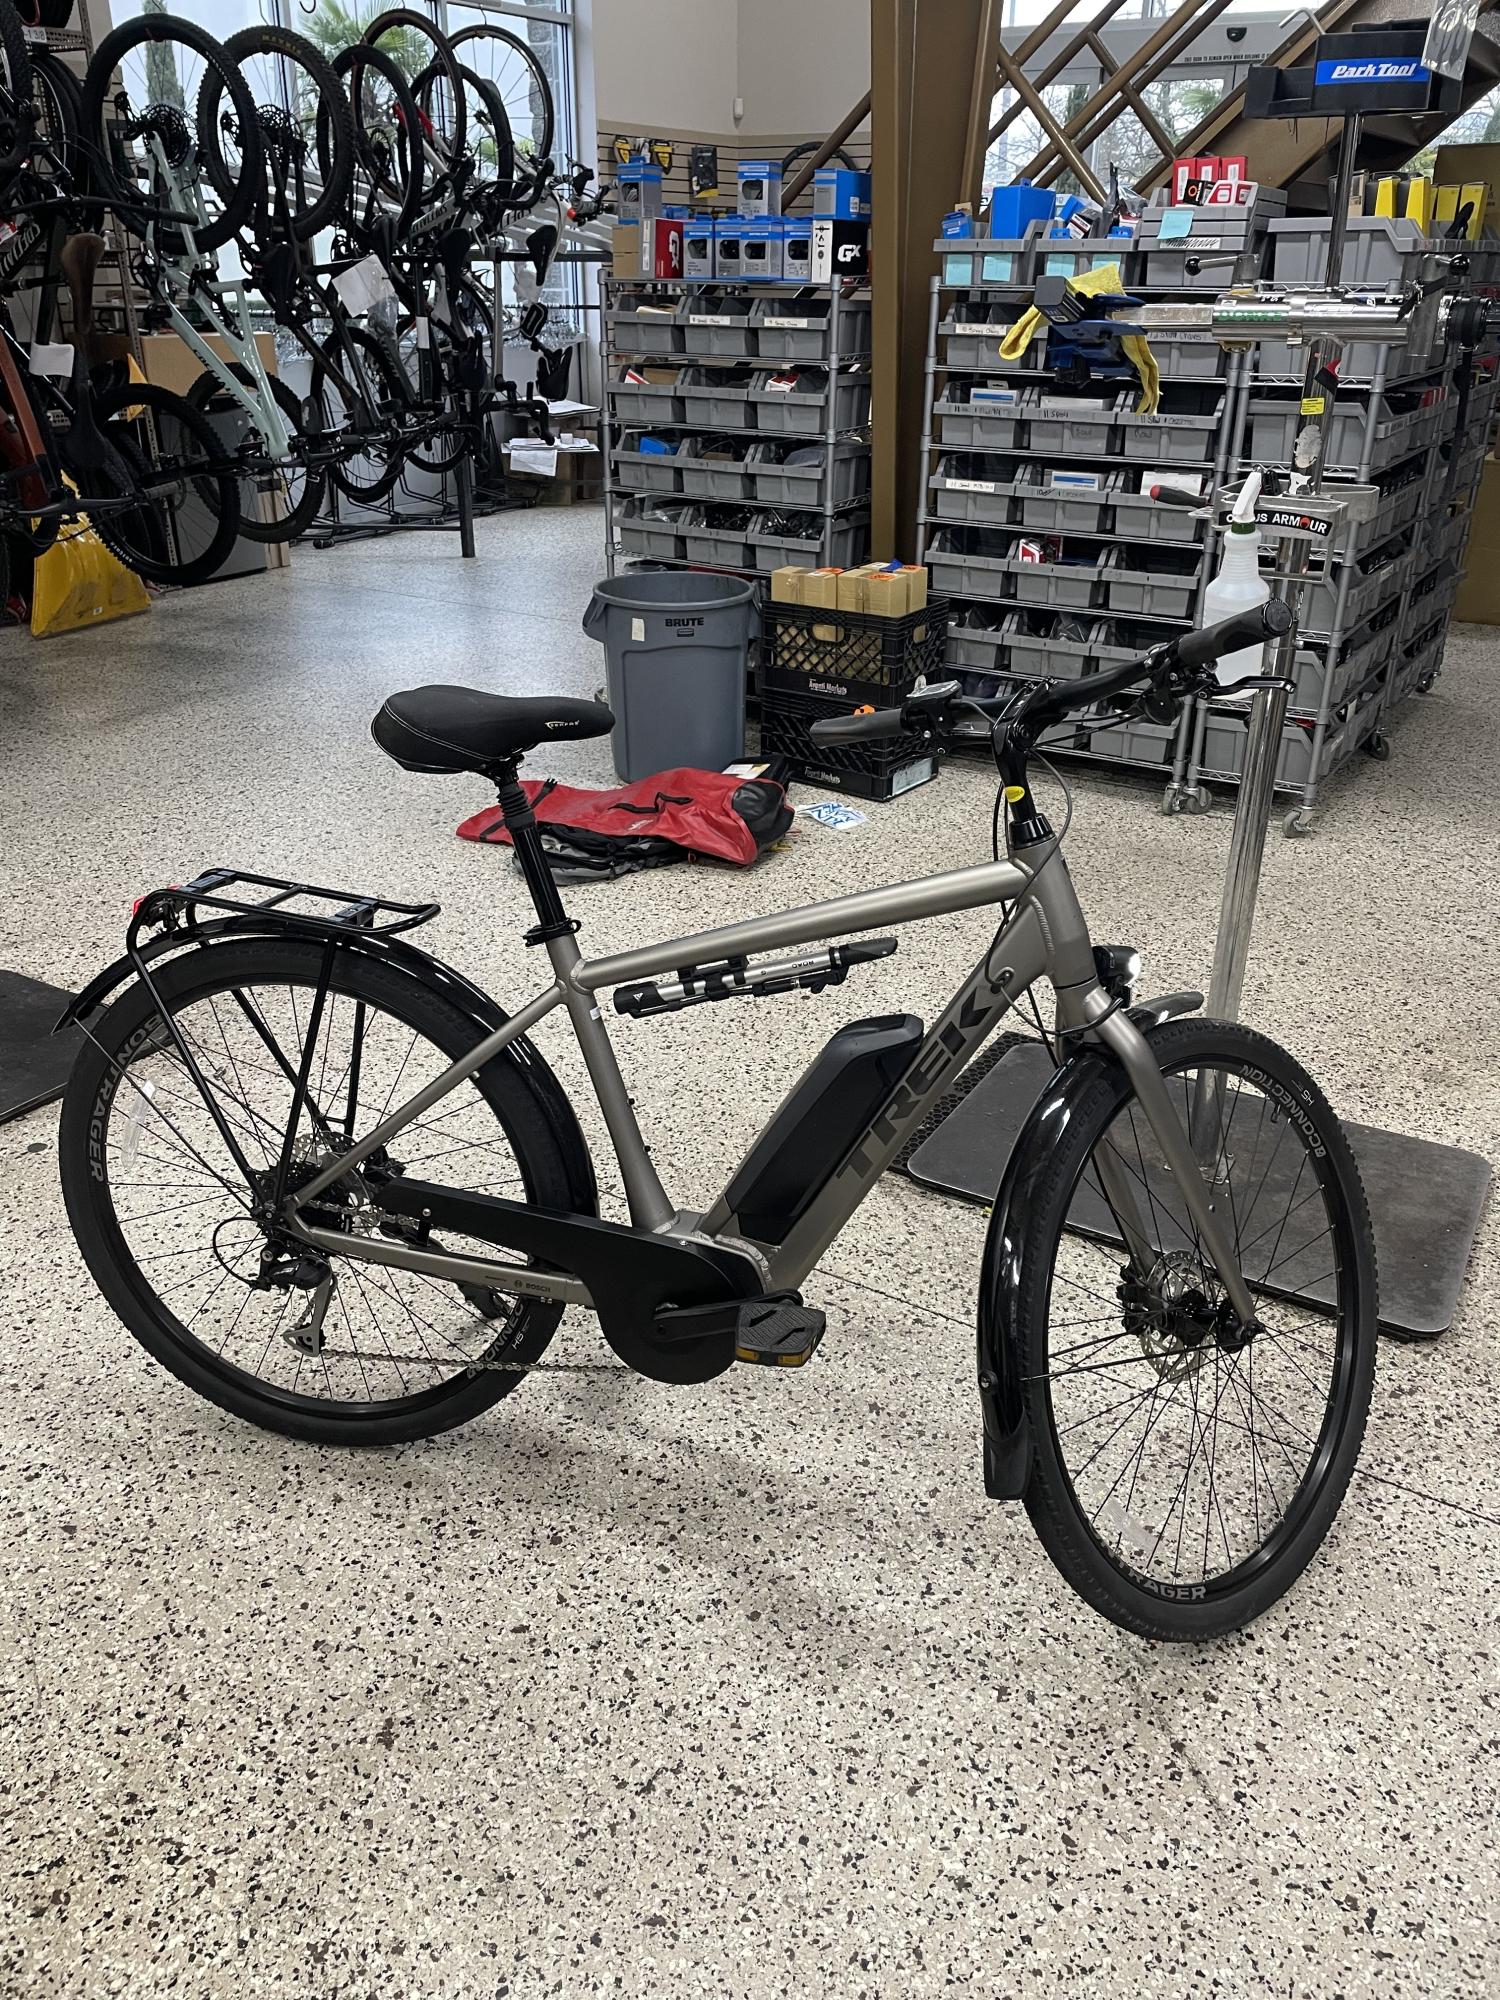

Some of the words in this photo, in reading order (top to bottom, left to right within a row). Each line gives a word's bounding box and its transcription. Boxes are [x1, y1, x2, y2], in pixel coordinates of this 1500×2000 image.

[1331, 64, 1377, 79] Park
[1378, 63, 1417, 77] Tool
[837, 244, 862, 263] GX
[1271, 514, 1328, 534] ARMOUR
[664, 617, 705, 627] BRUTE
[791, 960, 815, 969] ROAD
[836, 987, 993, 1179] TREK
[89, 1013, 166, 1183] BONTRAGER
[1239, 1063, 1317, 1148] CONNECTION
[525, 1282, 552, 1293] BOSCH
